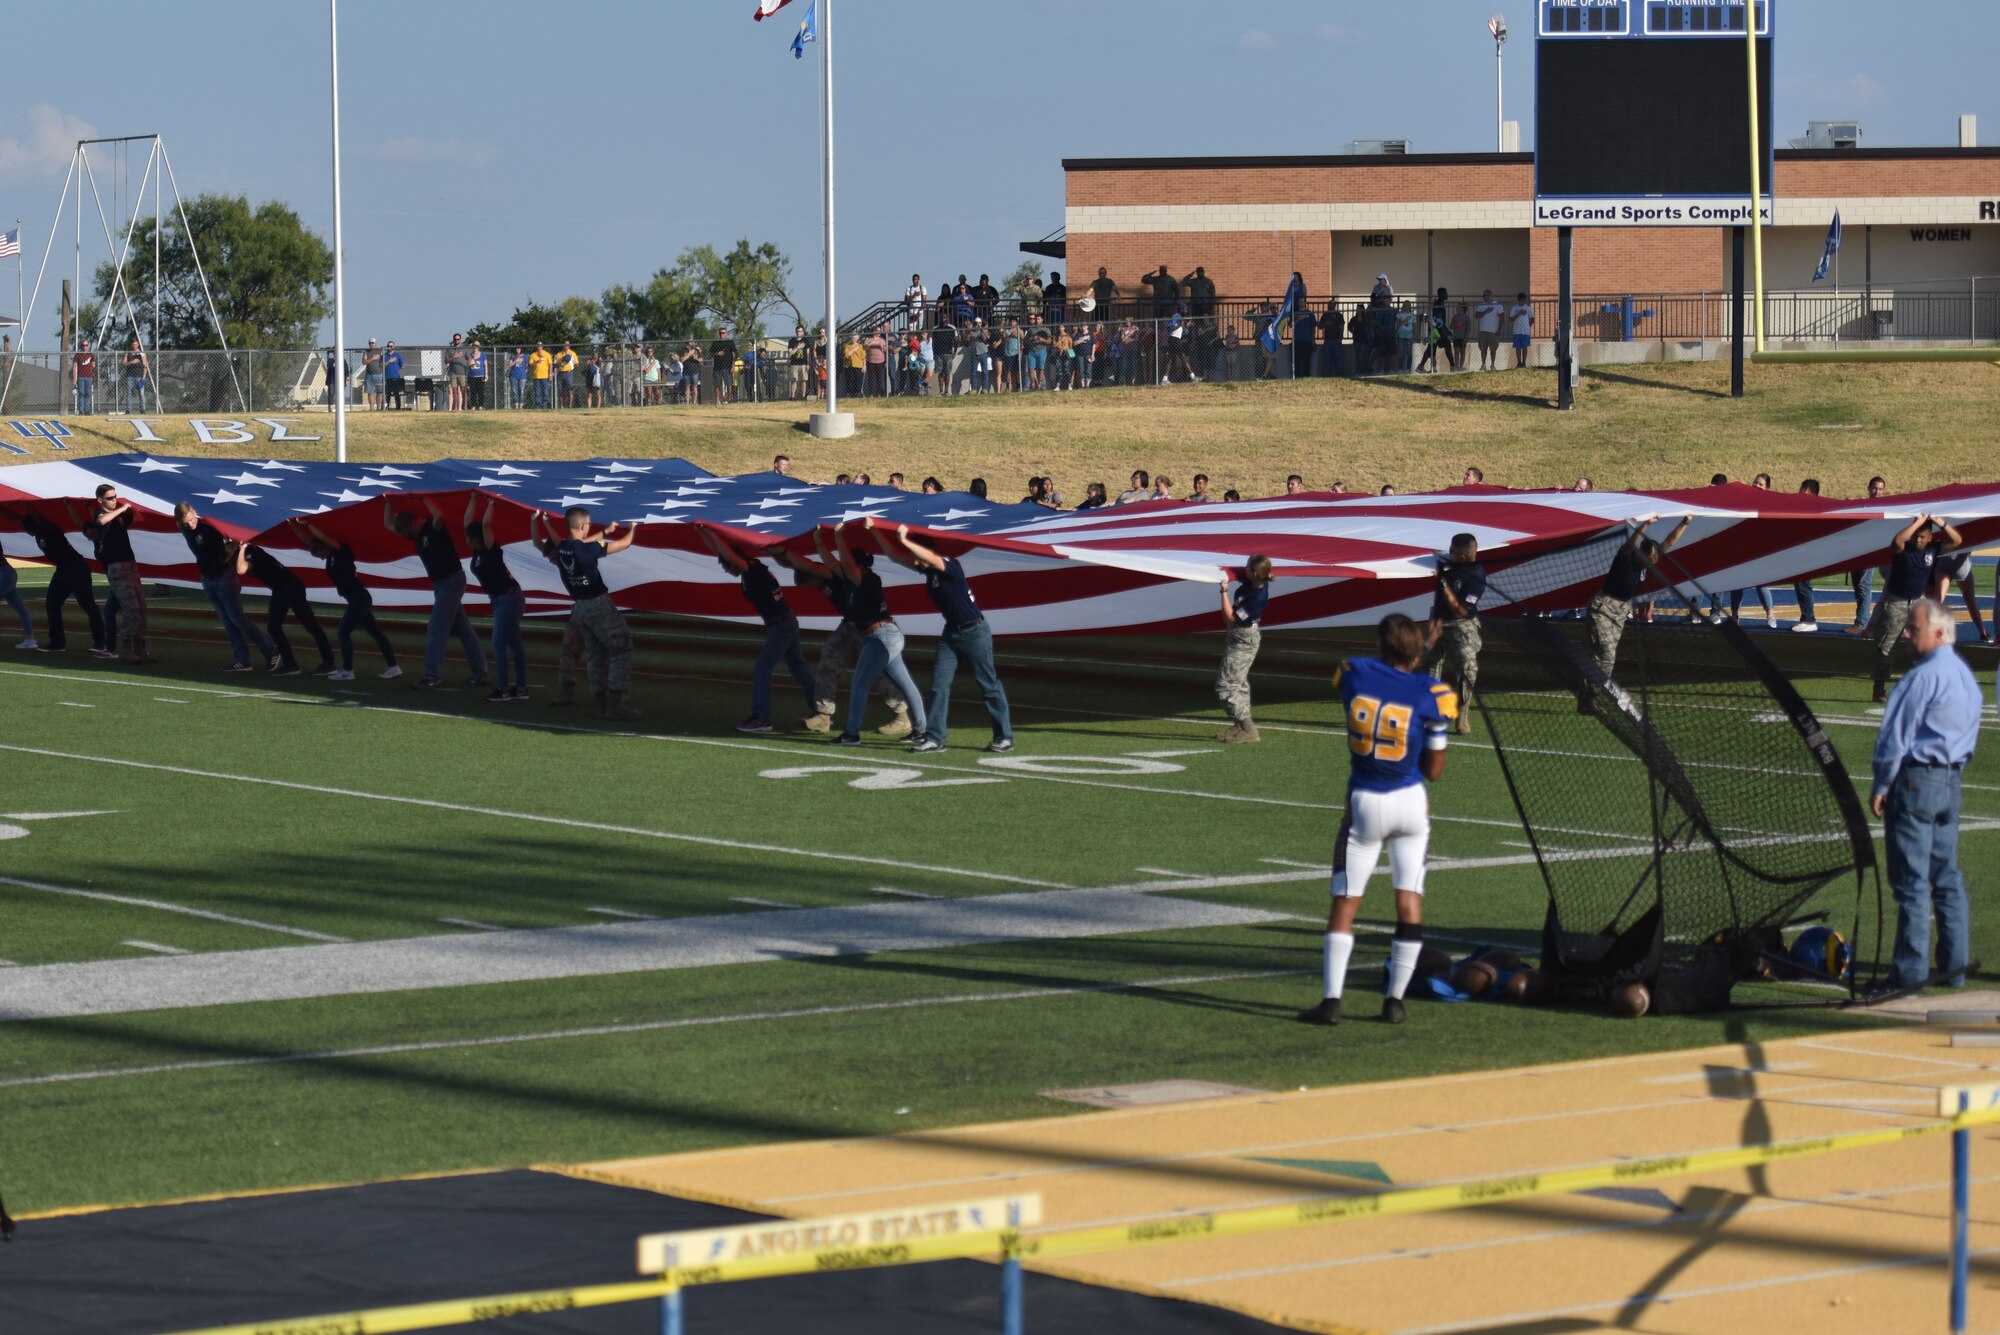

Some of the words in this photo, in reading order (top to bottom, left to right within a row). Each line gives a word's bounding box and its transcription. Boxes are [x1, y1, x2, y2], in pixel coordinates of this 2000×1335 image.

[1538, 206, 1616, 220] LeGrand
[1621, 206, 1682, 222] Sports
[1979, 201, 2000, 220] R
[1361, 234, 1393, 247] MEN
[1910, 228, 1971, 242] WOMEN
[1351, 694, 1413, 762] 99
[736, 1221, 860, 1257] ANGELO
[869, 1209, 960, 1241] STATE
